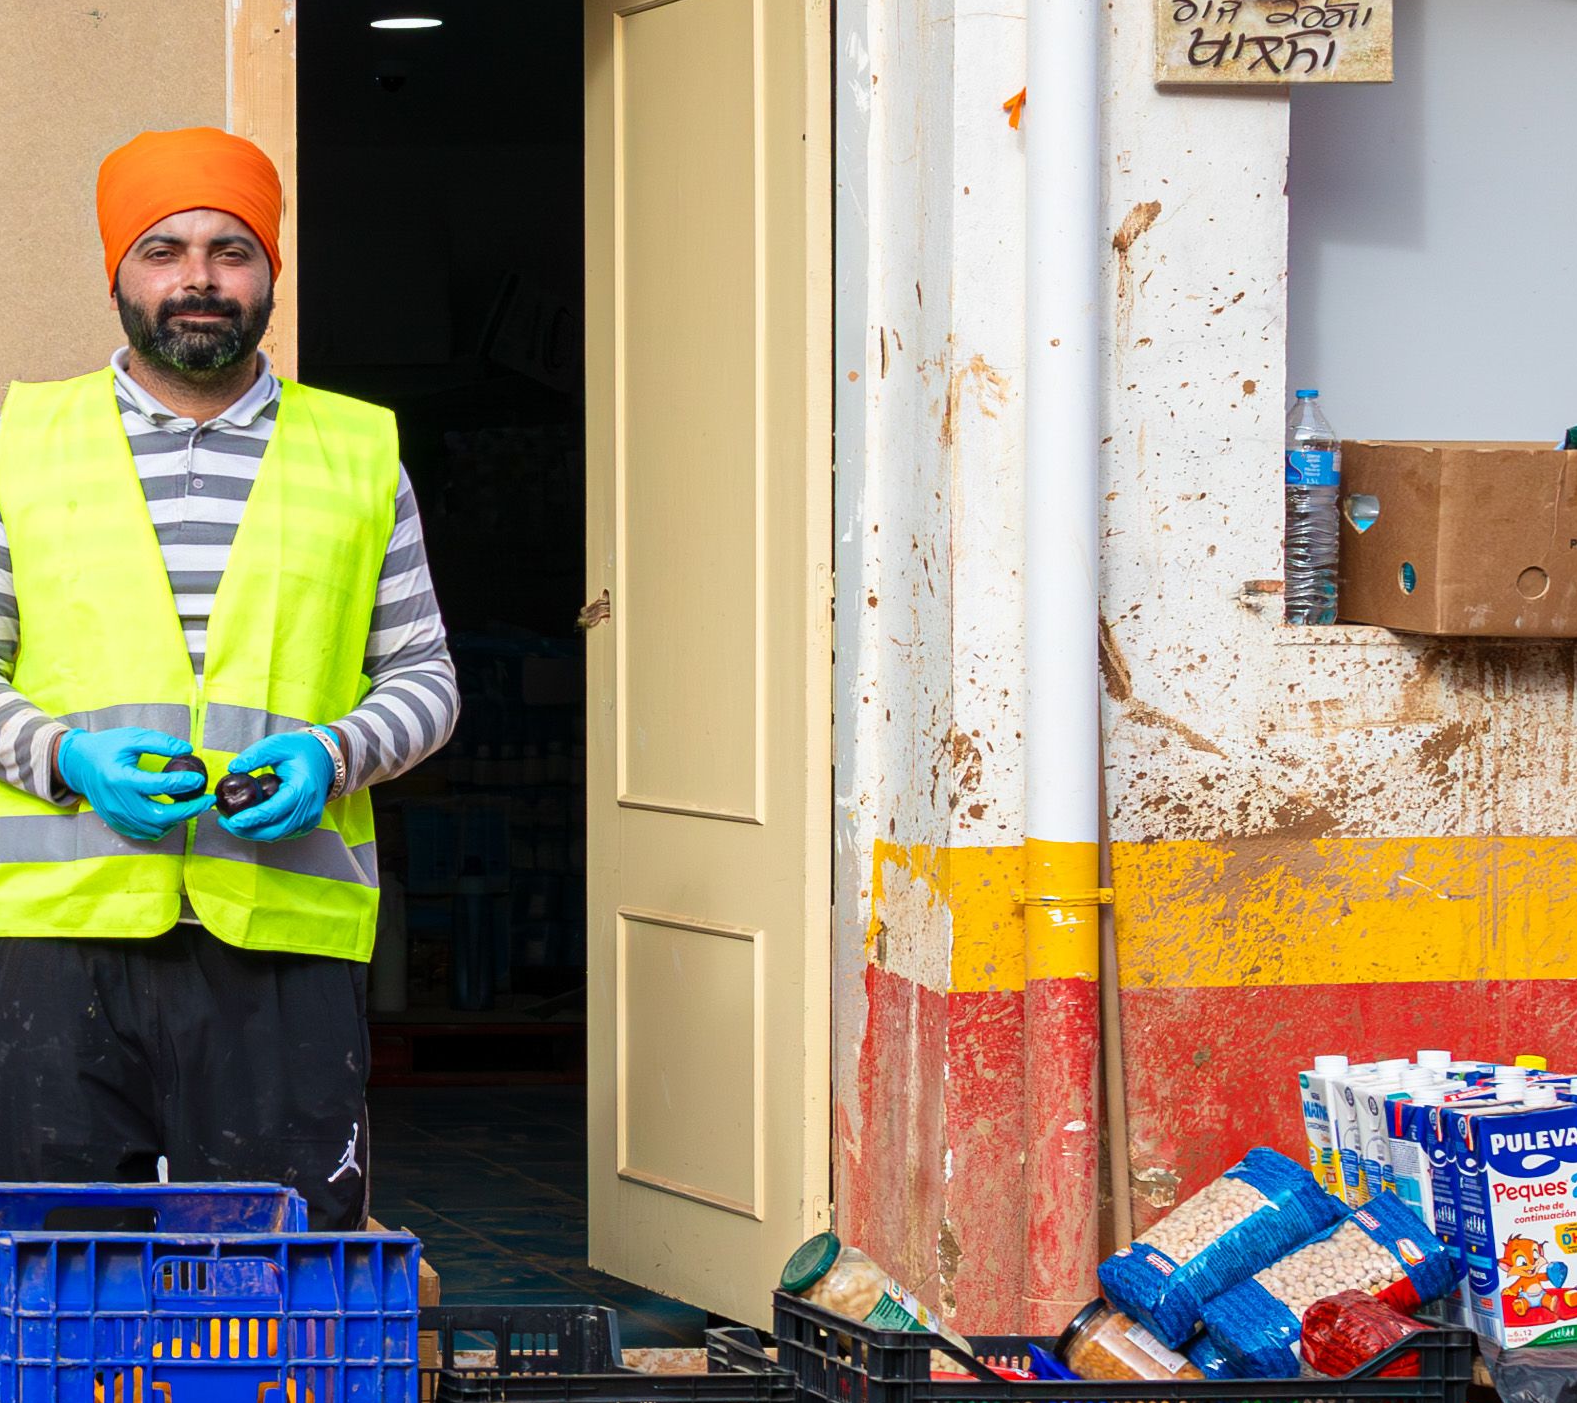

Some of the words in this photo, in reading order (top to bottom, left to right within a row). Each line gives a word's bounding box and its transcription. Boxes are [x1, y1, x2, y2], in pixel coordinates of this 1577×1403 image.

[1493, 1181, 1568, 1203] Peques
[1523, 1203, 1550, 1214] Leche
[1552, 1202, 1564, 1210] de
[1514, 1210, 1577, 1224] continuación
